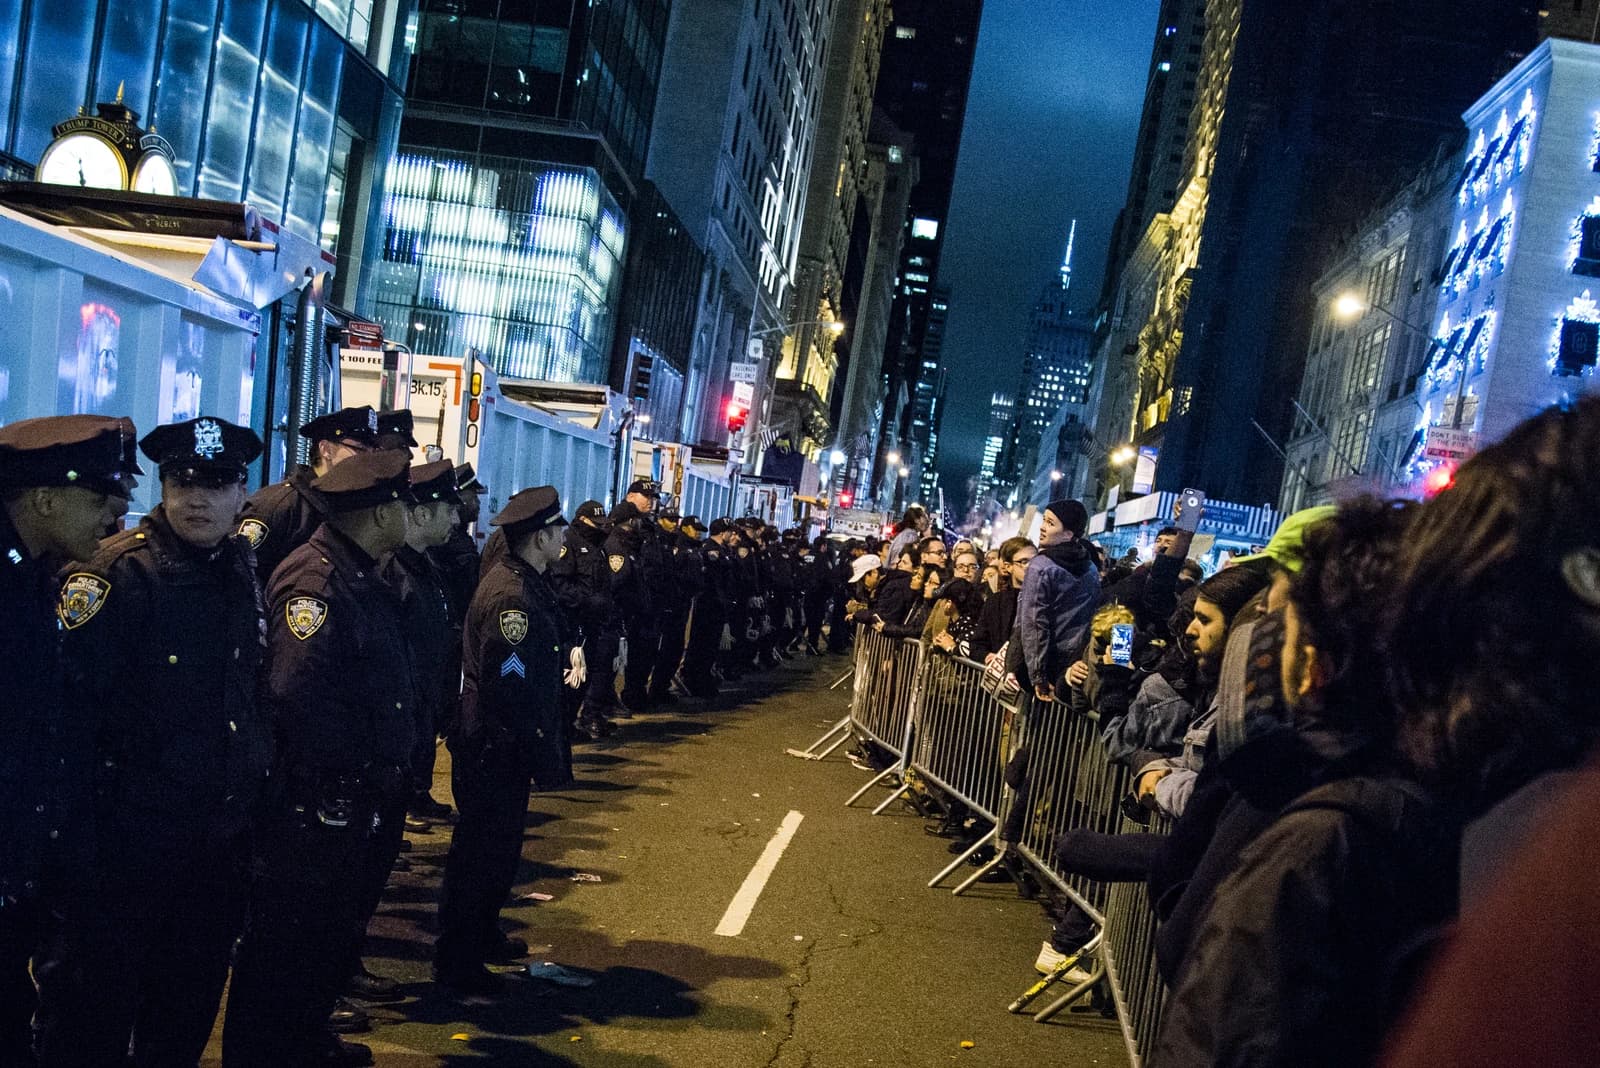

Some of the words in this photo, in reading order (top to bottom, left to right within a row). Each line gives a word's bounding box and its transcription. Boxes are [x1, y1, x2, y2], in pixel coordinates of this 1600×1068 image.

[62, 119, 90, 132] TRUMP
[93, 120, 119, 139] TOWER
[368, 357, 383, 365] FEE
[77, 577, 99, 587] POLICE
[298, 599, 318, 608] POLICE
